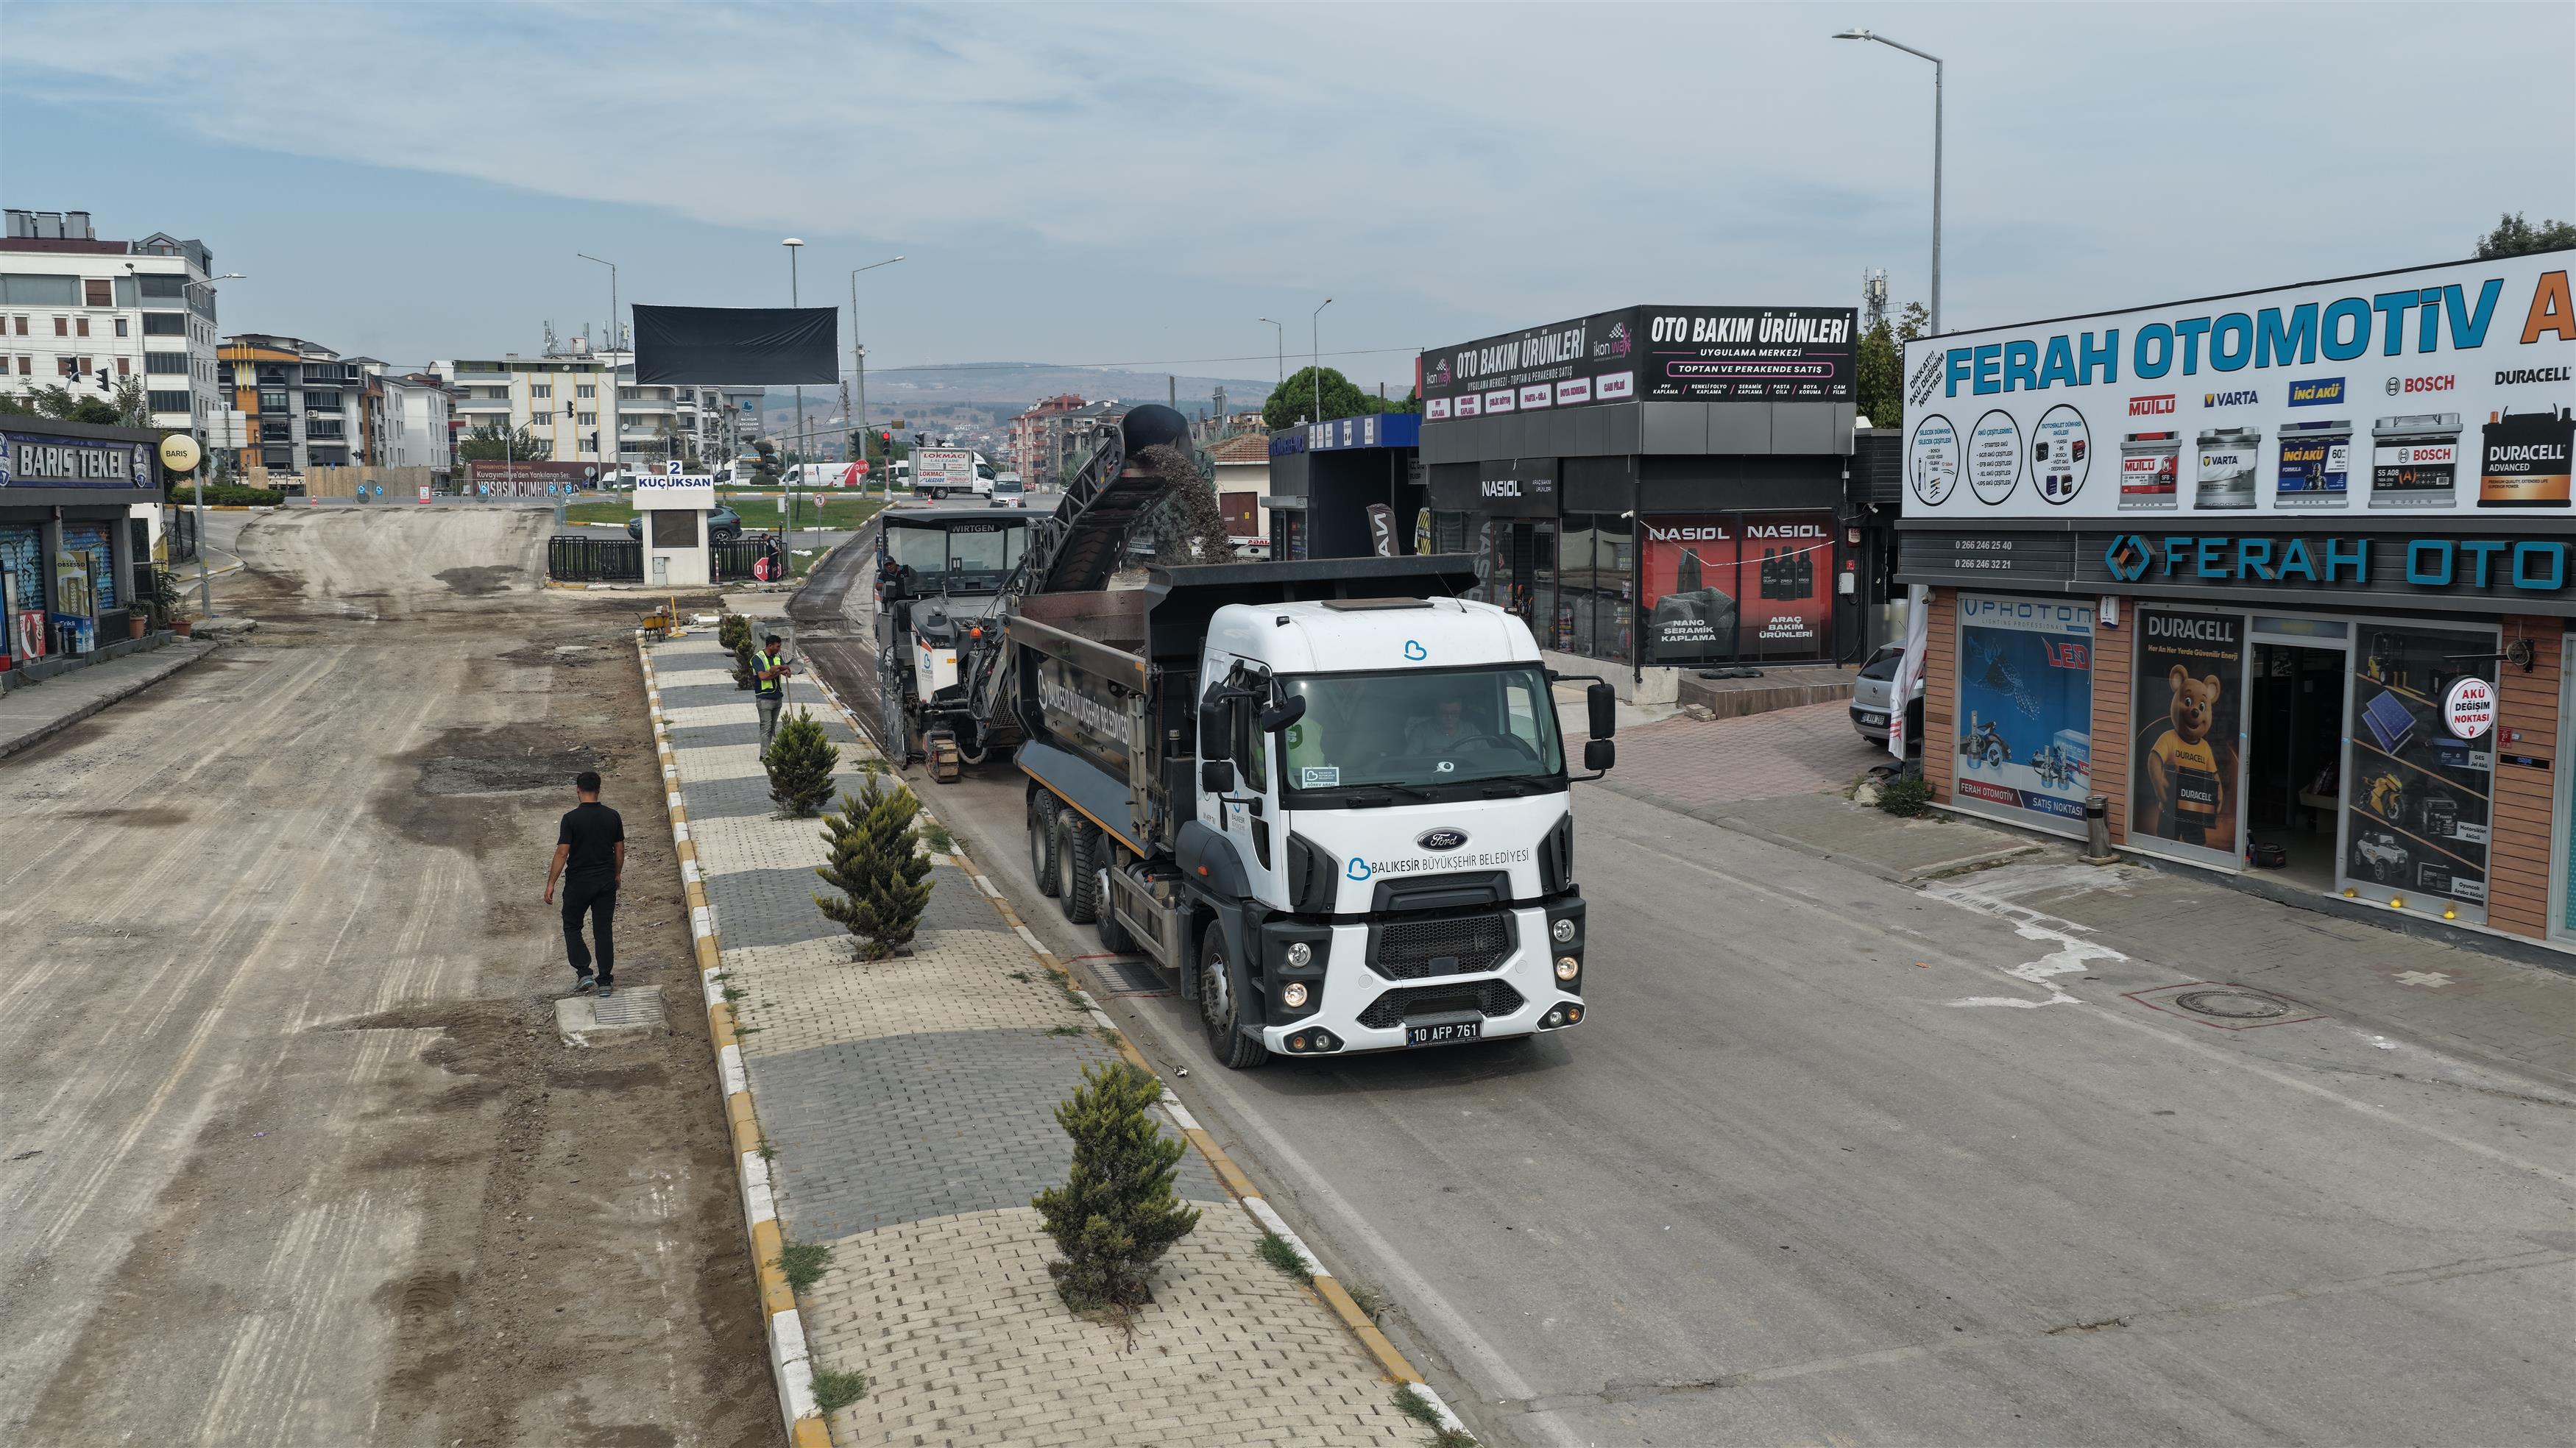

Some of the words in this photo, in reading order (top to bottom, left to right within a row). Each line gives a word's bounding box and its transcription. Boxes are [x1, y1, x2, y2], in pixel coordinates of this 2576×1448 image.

[1651, 316, 1687, 342] OTO
[1692, 317, 1755, 344] BAKIM
[1758, 312, 1850, 344] ÜRÜNLERİ
[1945, 329, 2119, 398] FERAH
[2134, 278, 2505, 379] OTOMOTİV
[1457, 350, 1477, 380] OTO
[1480, 341, 1519, 375] BAKIM
[1521, 319, 1586, 369] ÜRÜNLERİ
[1699, 349, 1756, 357] UYGULAMA
[1758, 347, 1802, 357] MERKEZİ
[1679, 365, 1719, 373] TOPTAN
[1794, 366, 1822, 375] SATIŞ
[1909, 349, 1936, 389] DİKKAT!!!
[1909, 386, 1921, 406] AKÜ
[1920, 352, 1945, 388] DEĞİŞİM
[2494, 367, 2571, 386] DURACELL
[1918, 371, 1943, 408] NOKTASI
[2316, 383, 2339, 399] AKÜ
[2405, 375, 2455, 393] BOSCH
[2129, 394, 2176, 416] MUTLU
[2216, 390, 2258, 406] VARTA
[166, 450, 187, 459] BARIŞ
[2332, 449, 2341, 459] 60
[2413, 448, 2451, 461] BOSCH
[2490, 444, 2565, 461] DURACELL
[79, 450, 127, 478] TEKEL
[2124, 458, 2155, 472] MUTLU
[2212, 455, 2237, 465] VARTA
[670, 461, 680, 475] 2
[2489, 463, 2530, 472] ADVANCED
[639, 477, 710, 489] KÜÇÜKSAN
[1482, 480, 1521, 497] NASIOL
[952, 524, 994, 533] WIRTGEN
[1649, 528, 1730, 540] NASIOL
[1747, 525, 1827, 538] NASIOL
[1956, 541, 1960, 549] 0
[1961, 541, 1975, 549] 266
[1976, 541, 1989, 550] 246
[1992, 541, 2000, 550] 25
[2002, 542, 2011, 550] 40
[1955, 559, 1959, 567] 0
[1961, 559, 1974, 568] 266
[1976, 559, 1989, 568] 246
[1991, 560, 2000, 569] 32
[2002, 560, 2011, 569] 21
[2164, 536, 2371, 583] FERAH
[1770, 616, 1802, 624] ARAÇ
[2014, 621, 2063, 631] PROFESSIONAL
[1663, 625, 1713, 634] SERAMİK
[1759, 631, 1813, 639] ÜRÜNLERİ
[2148, 617, 2234, 642] DURACELL
[1661, 634, 1716, 642] KAPLAMA
[2041, 636, 2090, 671] LED
[2177, 647, 2193, 656] Yerde
[2194, 649, 2221, 658] Güvenilir
[2221, 652, 2238, 661] Enerji
[2462, 686, 2485, 699] AKÜ
[2455, 700, 2490, 712] DEĞİŞİM
[2455, 714, 2489, 723] NOKTASI
[2176, 750, 2205, 764] DURACELL
[1961, 782, 1981, 795] FERAH
[1983, 788, 2014, 801] OTOMOTİV
[2181, 789, 2212, 801] DURACELL
[2033, 798, 2052, 811] SATIŞ
[2053, 803, 2083, 816] NOKTASI
[1430, 833, 1457, 847] Ford
[1372, 858, 1420, 873] BALIKESİR
[1423, 853, 1476, 870] BÜYÜKŞEHİR
[1479, 848, 1529, 865] BELEDİYESİ
[1414, 1029, 1426, 1042] 10
[1432, 1026, 1452, 1040] AFP
[1457, 1023, 1476, 1037] 761
